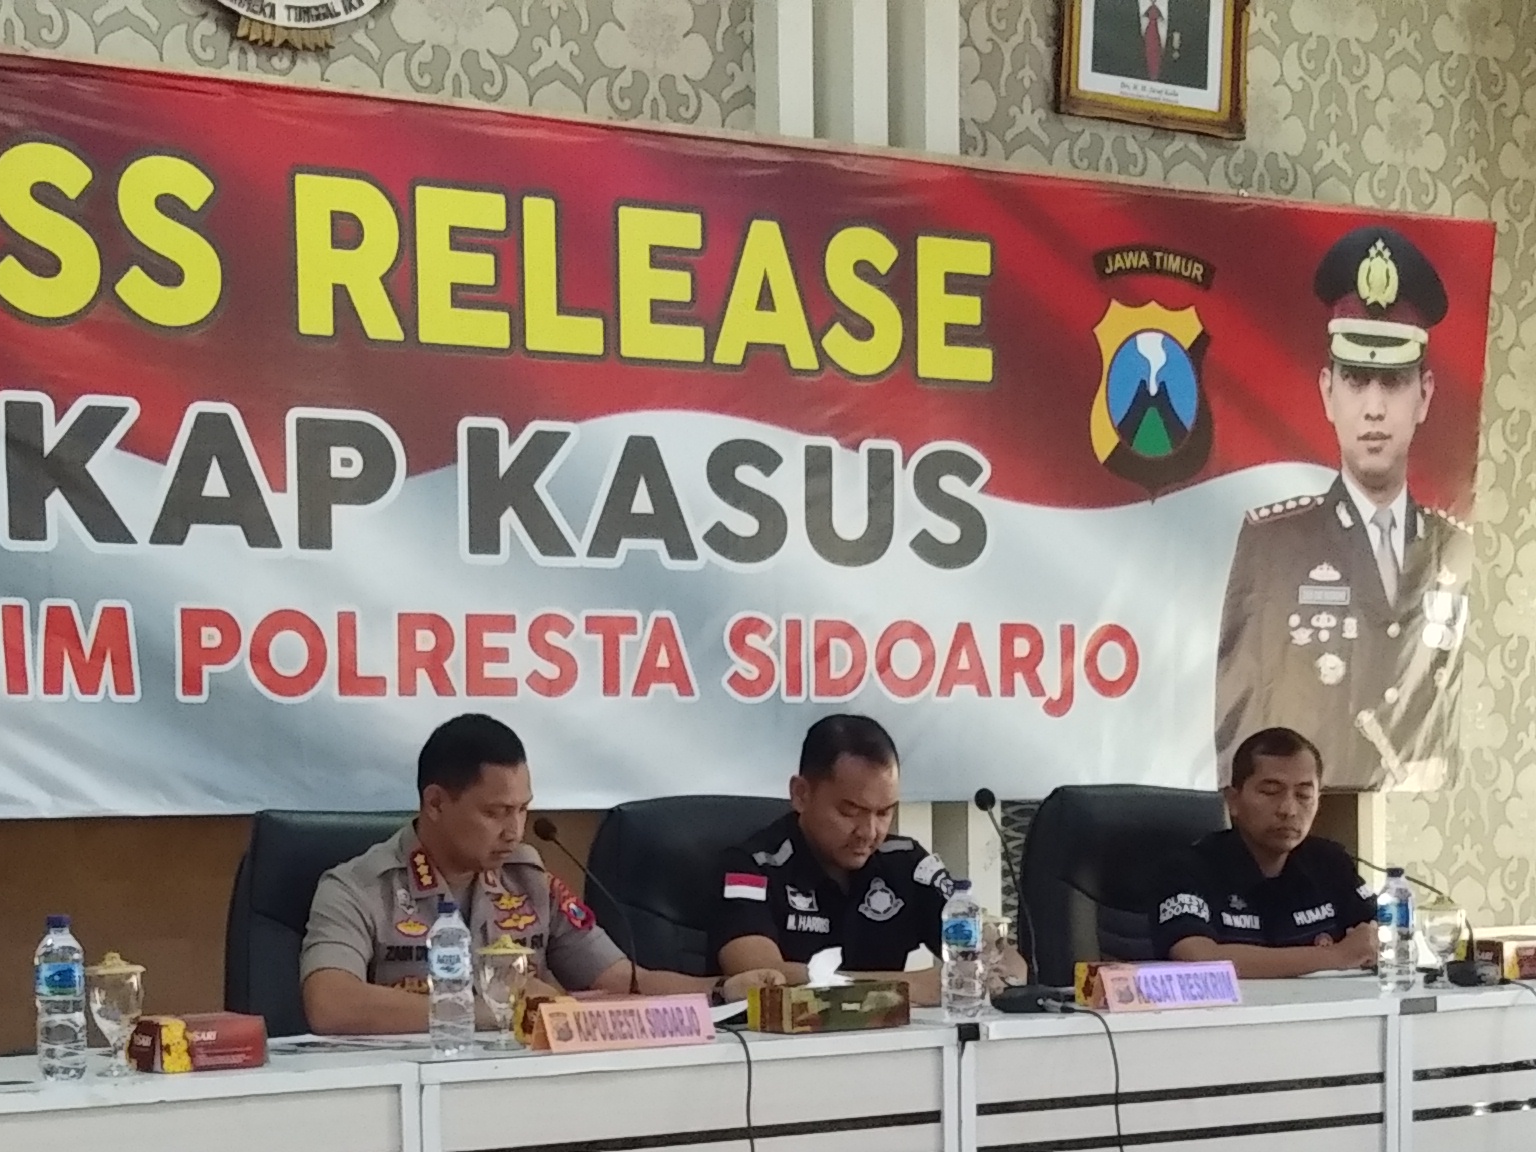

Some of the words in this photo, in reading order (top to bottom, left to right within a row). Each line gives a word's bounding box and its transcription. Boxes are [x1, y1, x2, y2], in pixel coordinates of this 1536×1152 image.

[294, 172, 995, 384] RELEASE
[1104, 250, 1150, 274] JAWA
[1153, 251, 1204, 283] TIMUR
[464, 426, 991, 570] KASUS
[181, 607, 696, 700] POLRESTA
[728, 616, 1141, 718] SIDOARJO
[1159, 893, 1209, 913] POLRESTA
[1293, 902, 1336, 926] HUMAS
[1133, 973, 1174, 1004] KASAT
[1175, 971, 1238, 1002] RESKRIM
[573, 1008, 648, 1042] KAPOLRESTA
[645, 1006, 702, 1039] SIDOARJO
